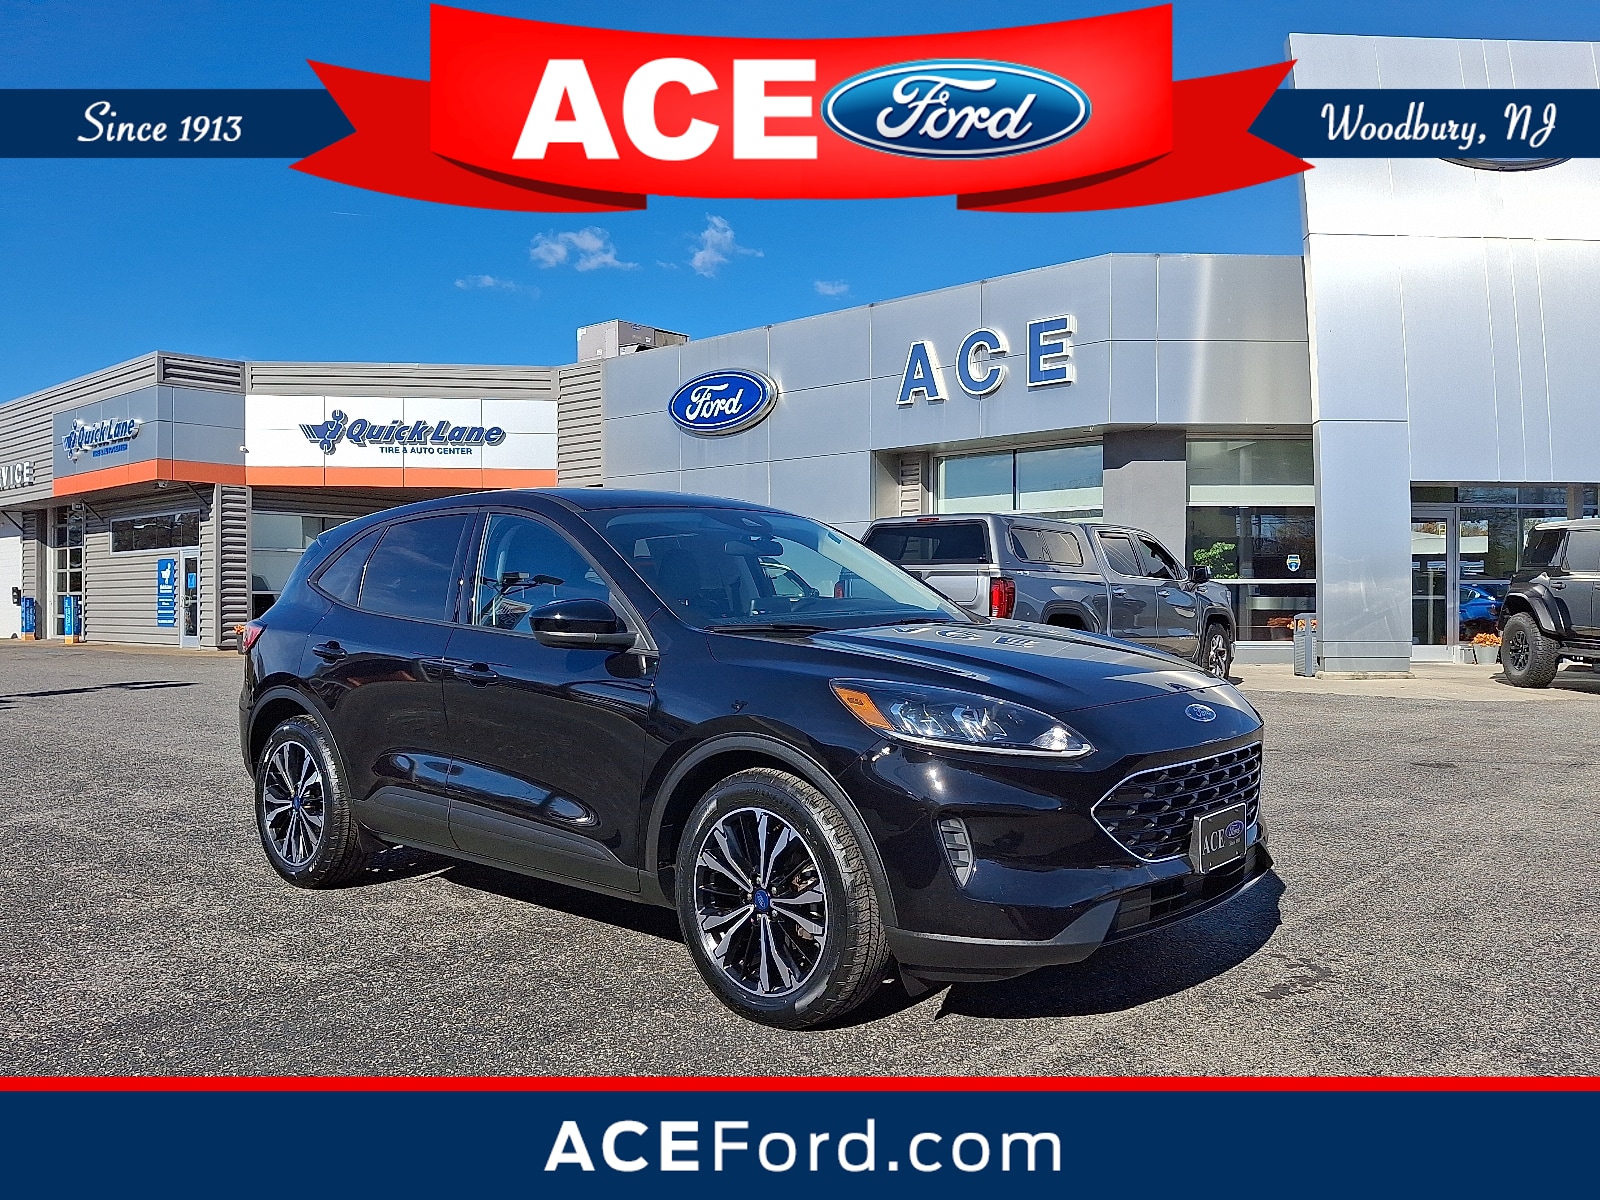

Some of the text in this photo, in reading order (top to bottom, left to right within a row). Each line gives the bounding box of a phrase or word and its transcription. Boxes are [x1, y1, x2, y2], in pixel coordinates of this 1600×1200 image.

[896, 313, 1078, 406] ACE
[685, 382, 744, 421] Ford
[78, 418, 137, 447] Quick Lane
[346, 418, 506, 447] Quick Lane
[379, 446, 400, 454] TIRE
[410, 447, 435, 455] AUTO
[437, 447, 473, 455] CENTER
[1202, 828, 1226, 856] ACE
